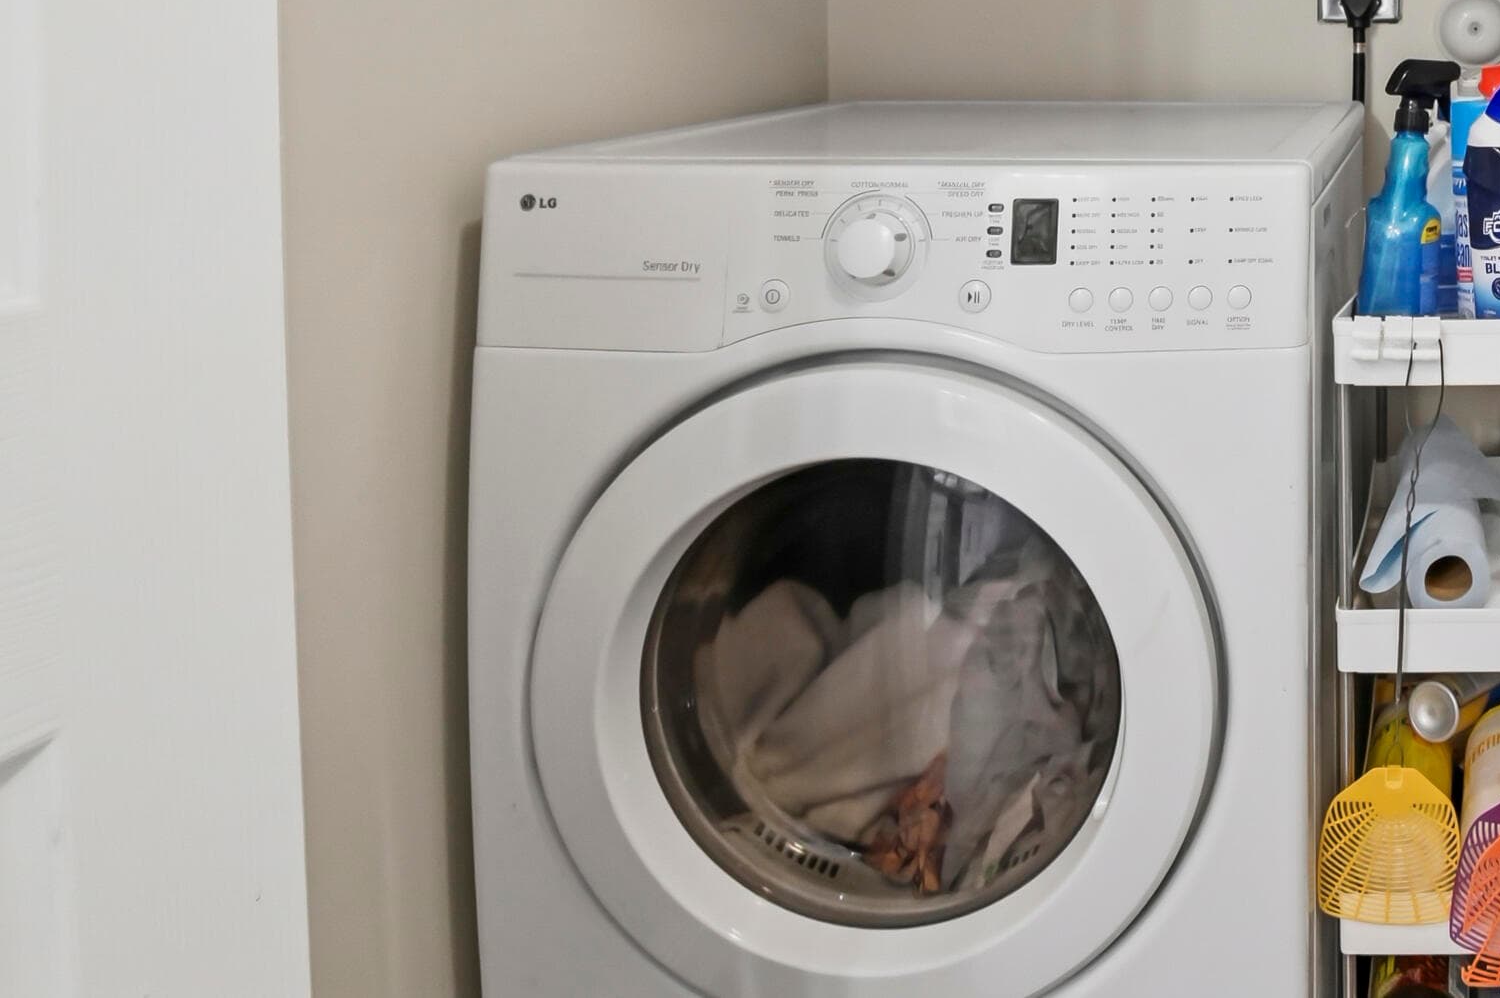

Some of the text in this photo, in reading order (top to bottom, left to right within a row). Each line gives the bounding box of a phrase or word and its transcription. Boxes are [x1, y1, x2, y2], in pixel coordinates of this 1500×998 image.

[538, 197, 557, 209] LG
[642, 260, 701, 274] Sensor Dry
